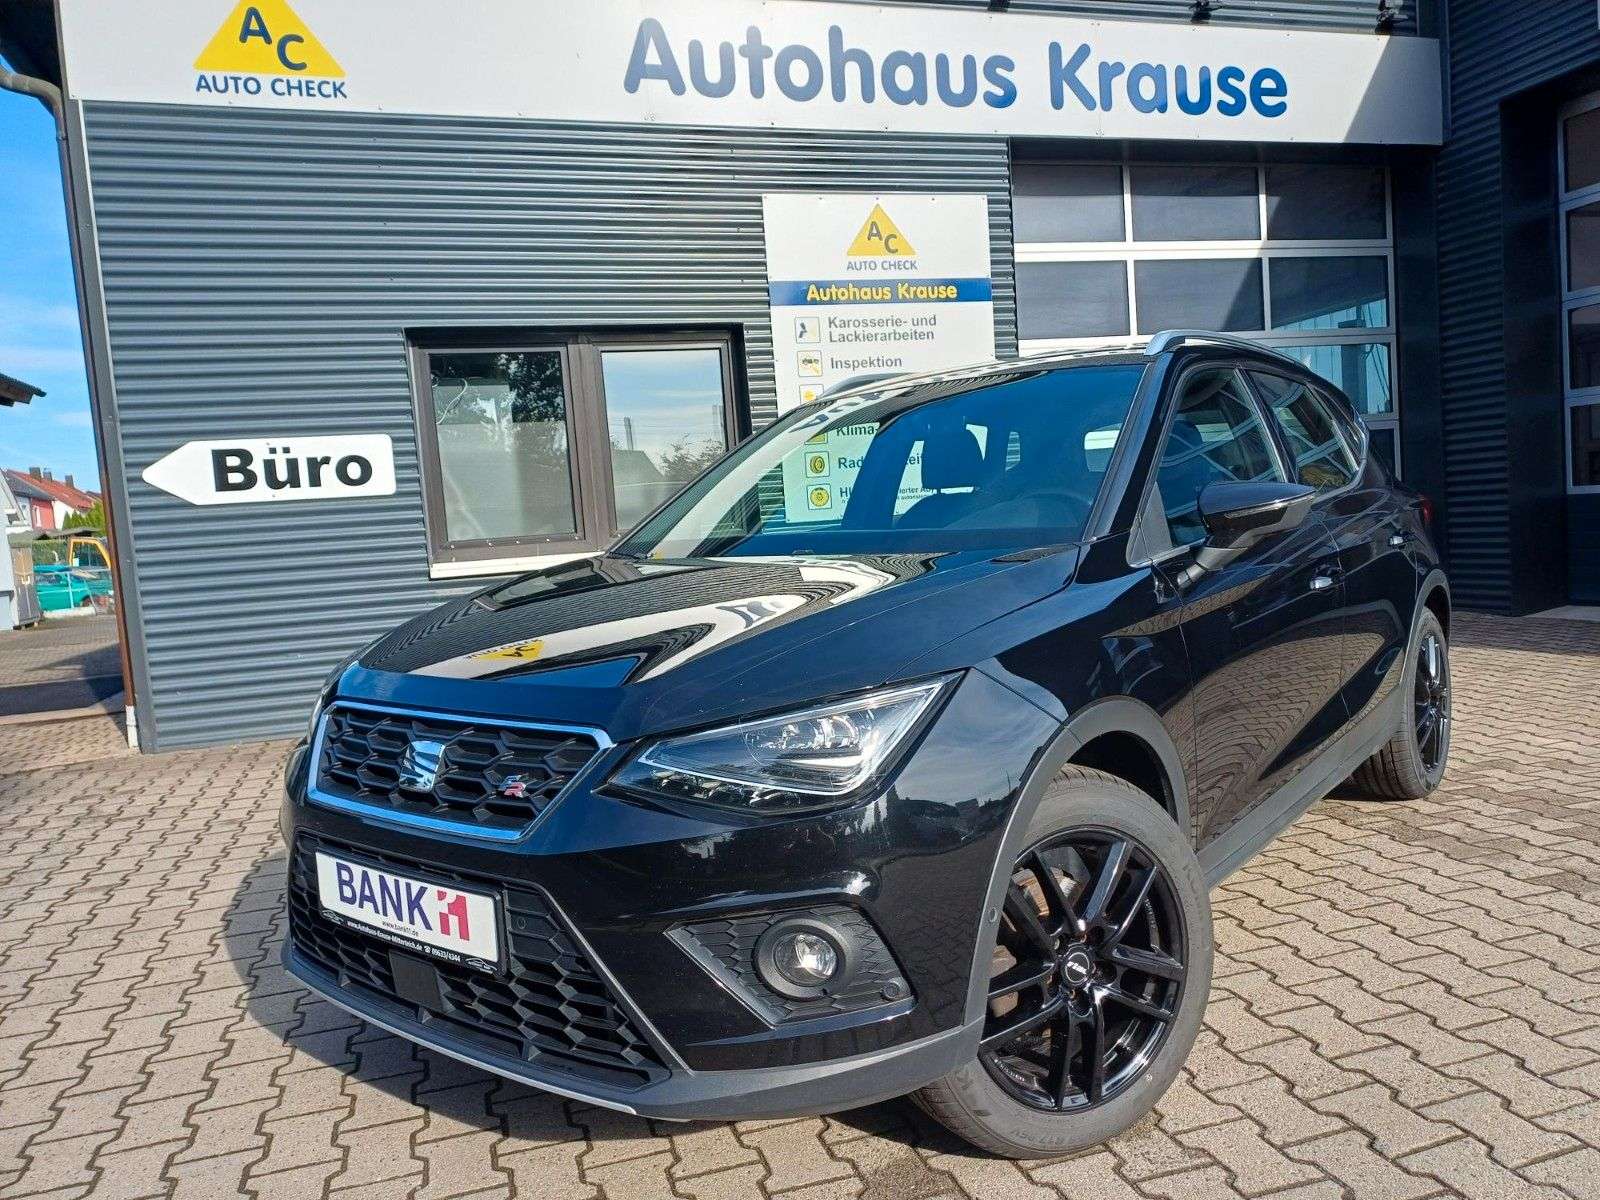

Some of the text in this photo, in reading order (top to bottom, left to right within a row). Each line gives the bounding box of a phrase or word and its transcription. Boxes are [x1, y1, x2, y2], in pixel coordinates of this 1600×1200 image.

[622, 17, 1289, 118] Autohaus Krause
[195, 74, 348, 99] AUTO CHECK
[846, 260, 918, 271] AUTO CHECK
[806, 282, 958, 302] Autohaus Krause
[828, 315, 937, 329] Karosserie- und
[829, 329, 935, 343] Lackierarbeiten
[830, 356, 902, 372] Inspektion
[211, 446, 374, 493] Büro
